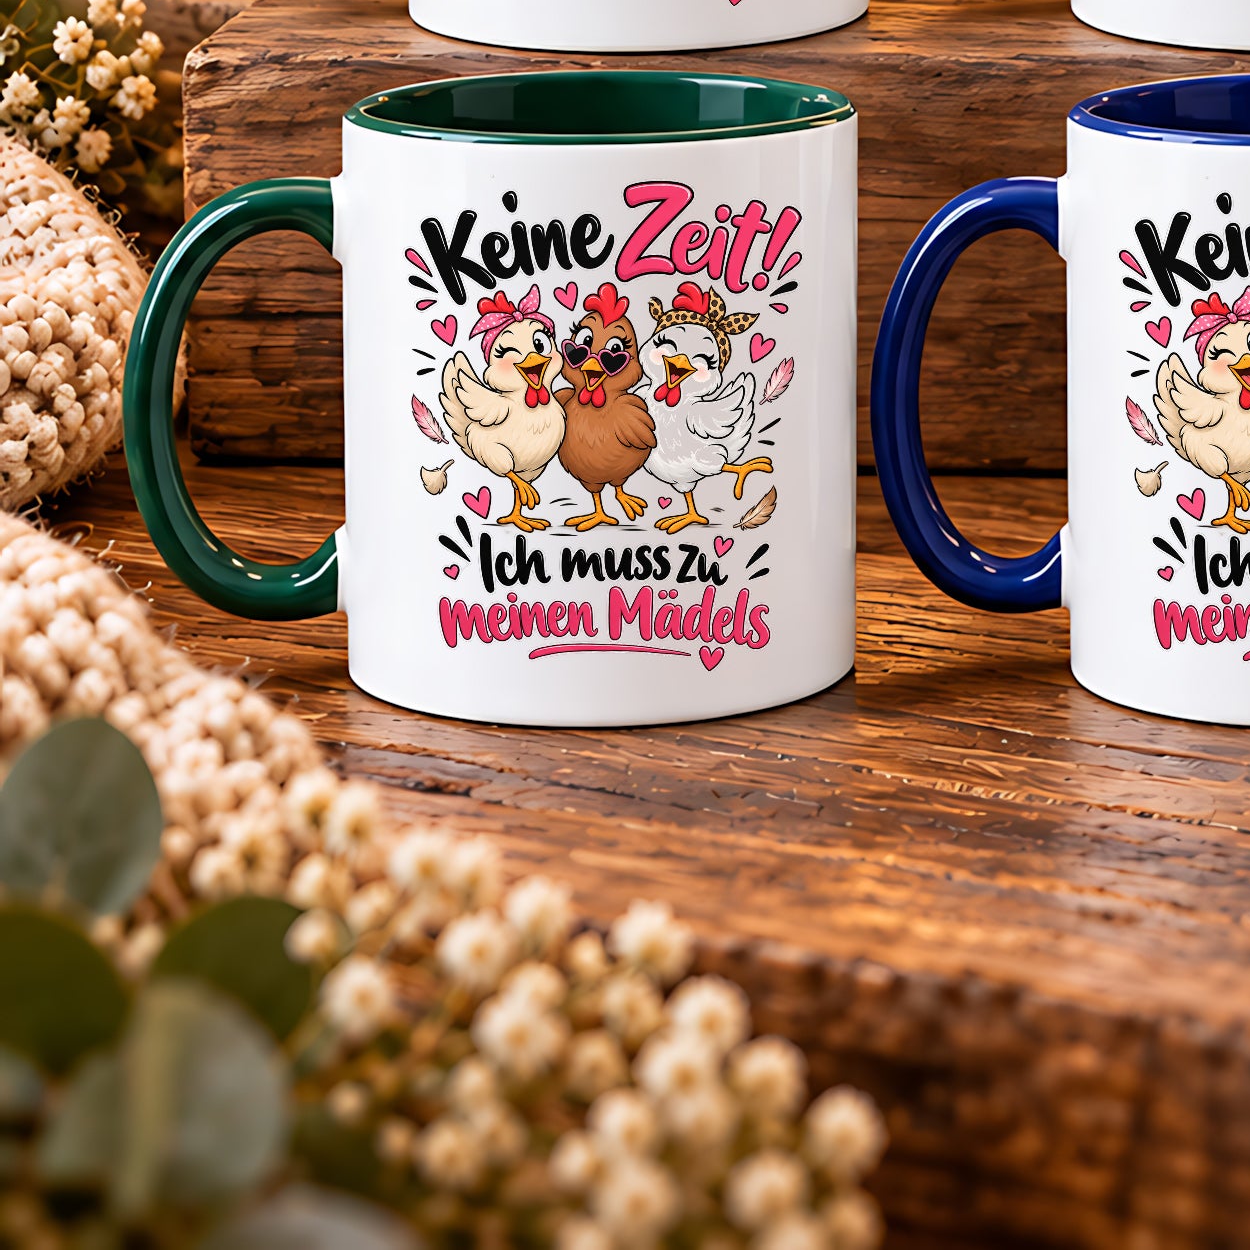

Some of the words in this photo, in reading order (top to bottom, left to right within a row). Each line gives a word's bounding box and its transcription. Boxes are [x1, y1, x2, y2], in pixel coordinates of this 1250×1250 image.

[420, 191, 614, 305] Keine
[614, 181, 801, 294] Zeit!
[478, 533, 550, 593] Ich
[562, 545, 672, 584] muss
[439, 594, 598, 648] meinen
[608, 586, 770, 649] Mädels
